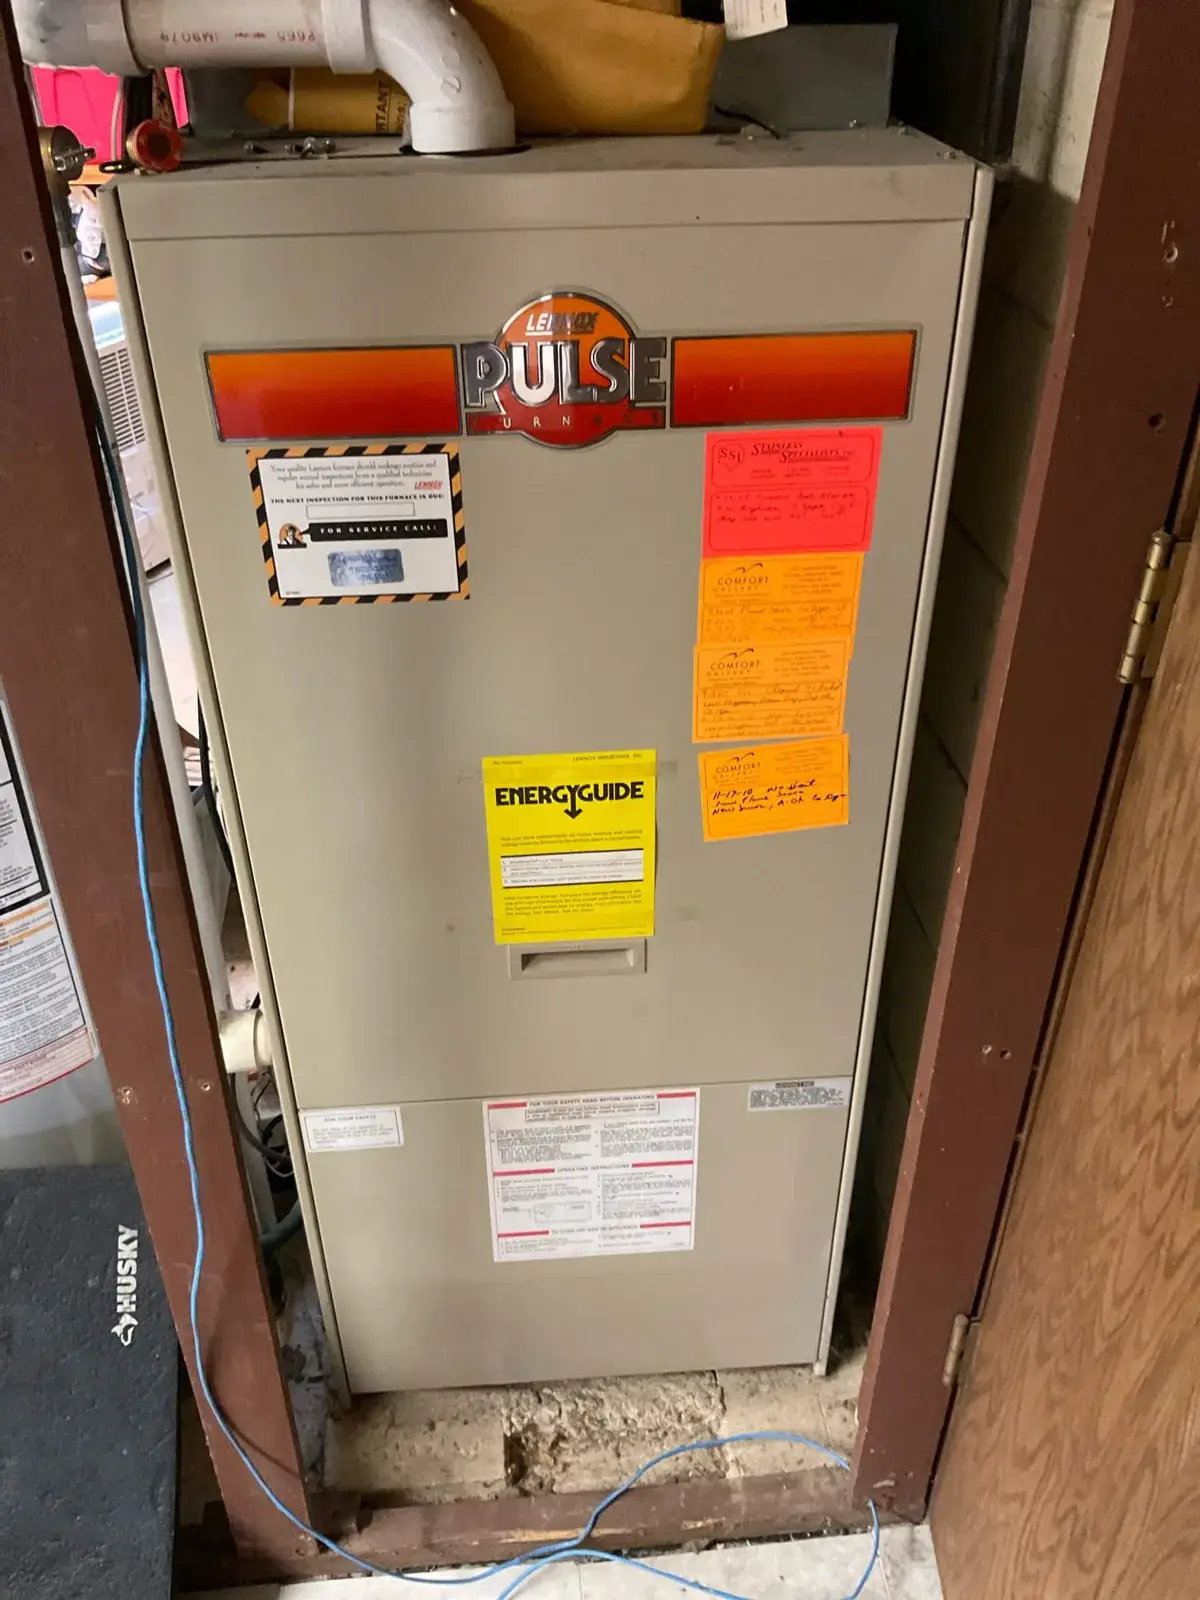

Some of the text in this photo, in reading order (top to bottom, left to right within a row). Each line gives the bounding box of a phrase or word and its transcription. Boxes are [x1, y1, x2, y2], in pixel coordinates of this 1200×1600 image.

[460, 337, 668, 409] PULSE
[287, 464, 307, 474] quality
[357, 460, 376, 470] should
[425, 459, 437, 468] and
[414, 480, 443, 490] LENNOX
[306, 495, 349, 504] INSPECTION
[367, 494, 383, 502] THIS
[385, 493, 417, 502] FURNACE
[320, 526, 342, 534] FOR
[349, 525, 398, 534] SERVICE
[717, 576, 769, 586] COMFORT
[710, 660, 760, 671] COMFORT
[716, 762, 761, 774] COMFORT
[495, 781, 644, 809] ENERGYGUIDE
[116, 1224, 139, 1313] HUSKY
